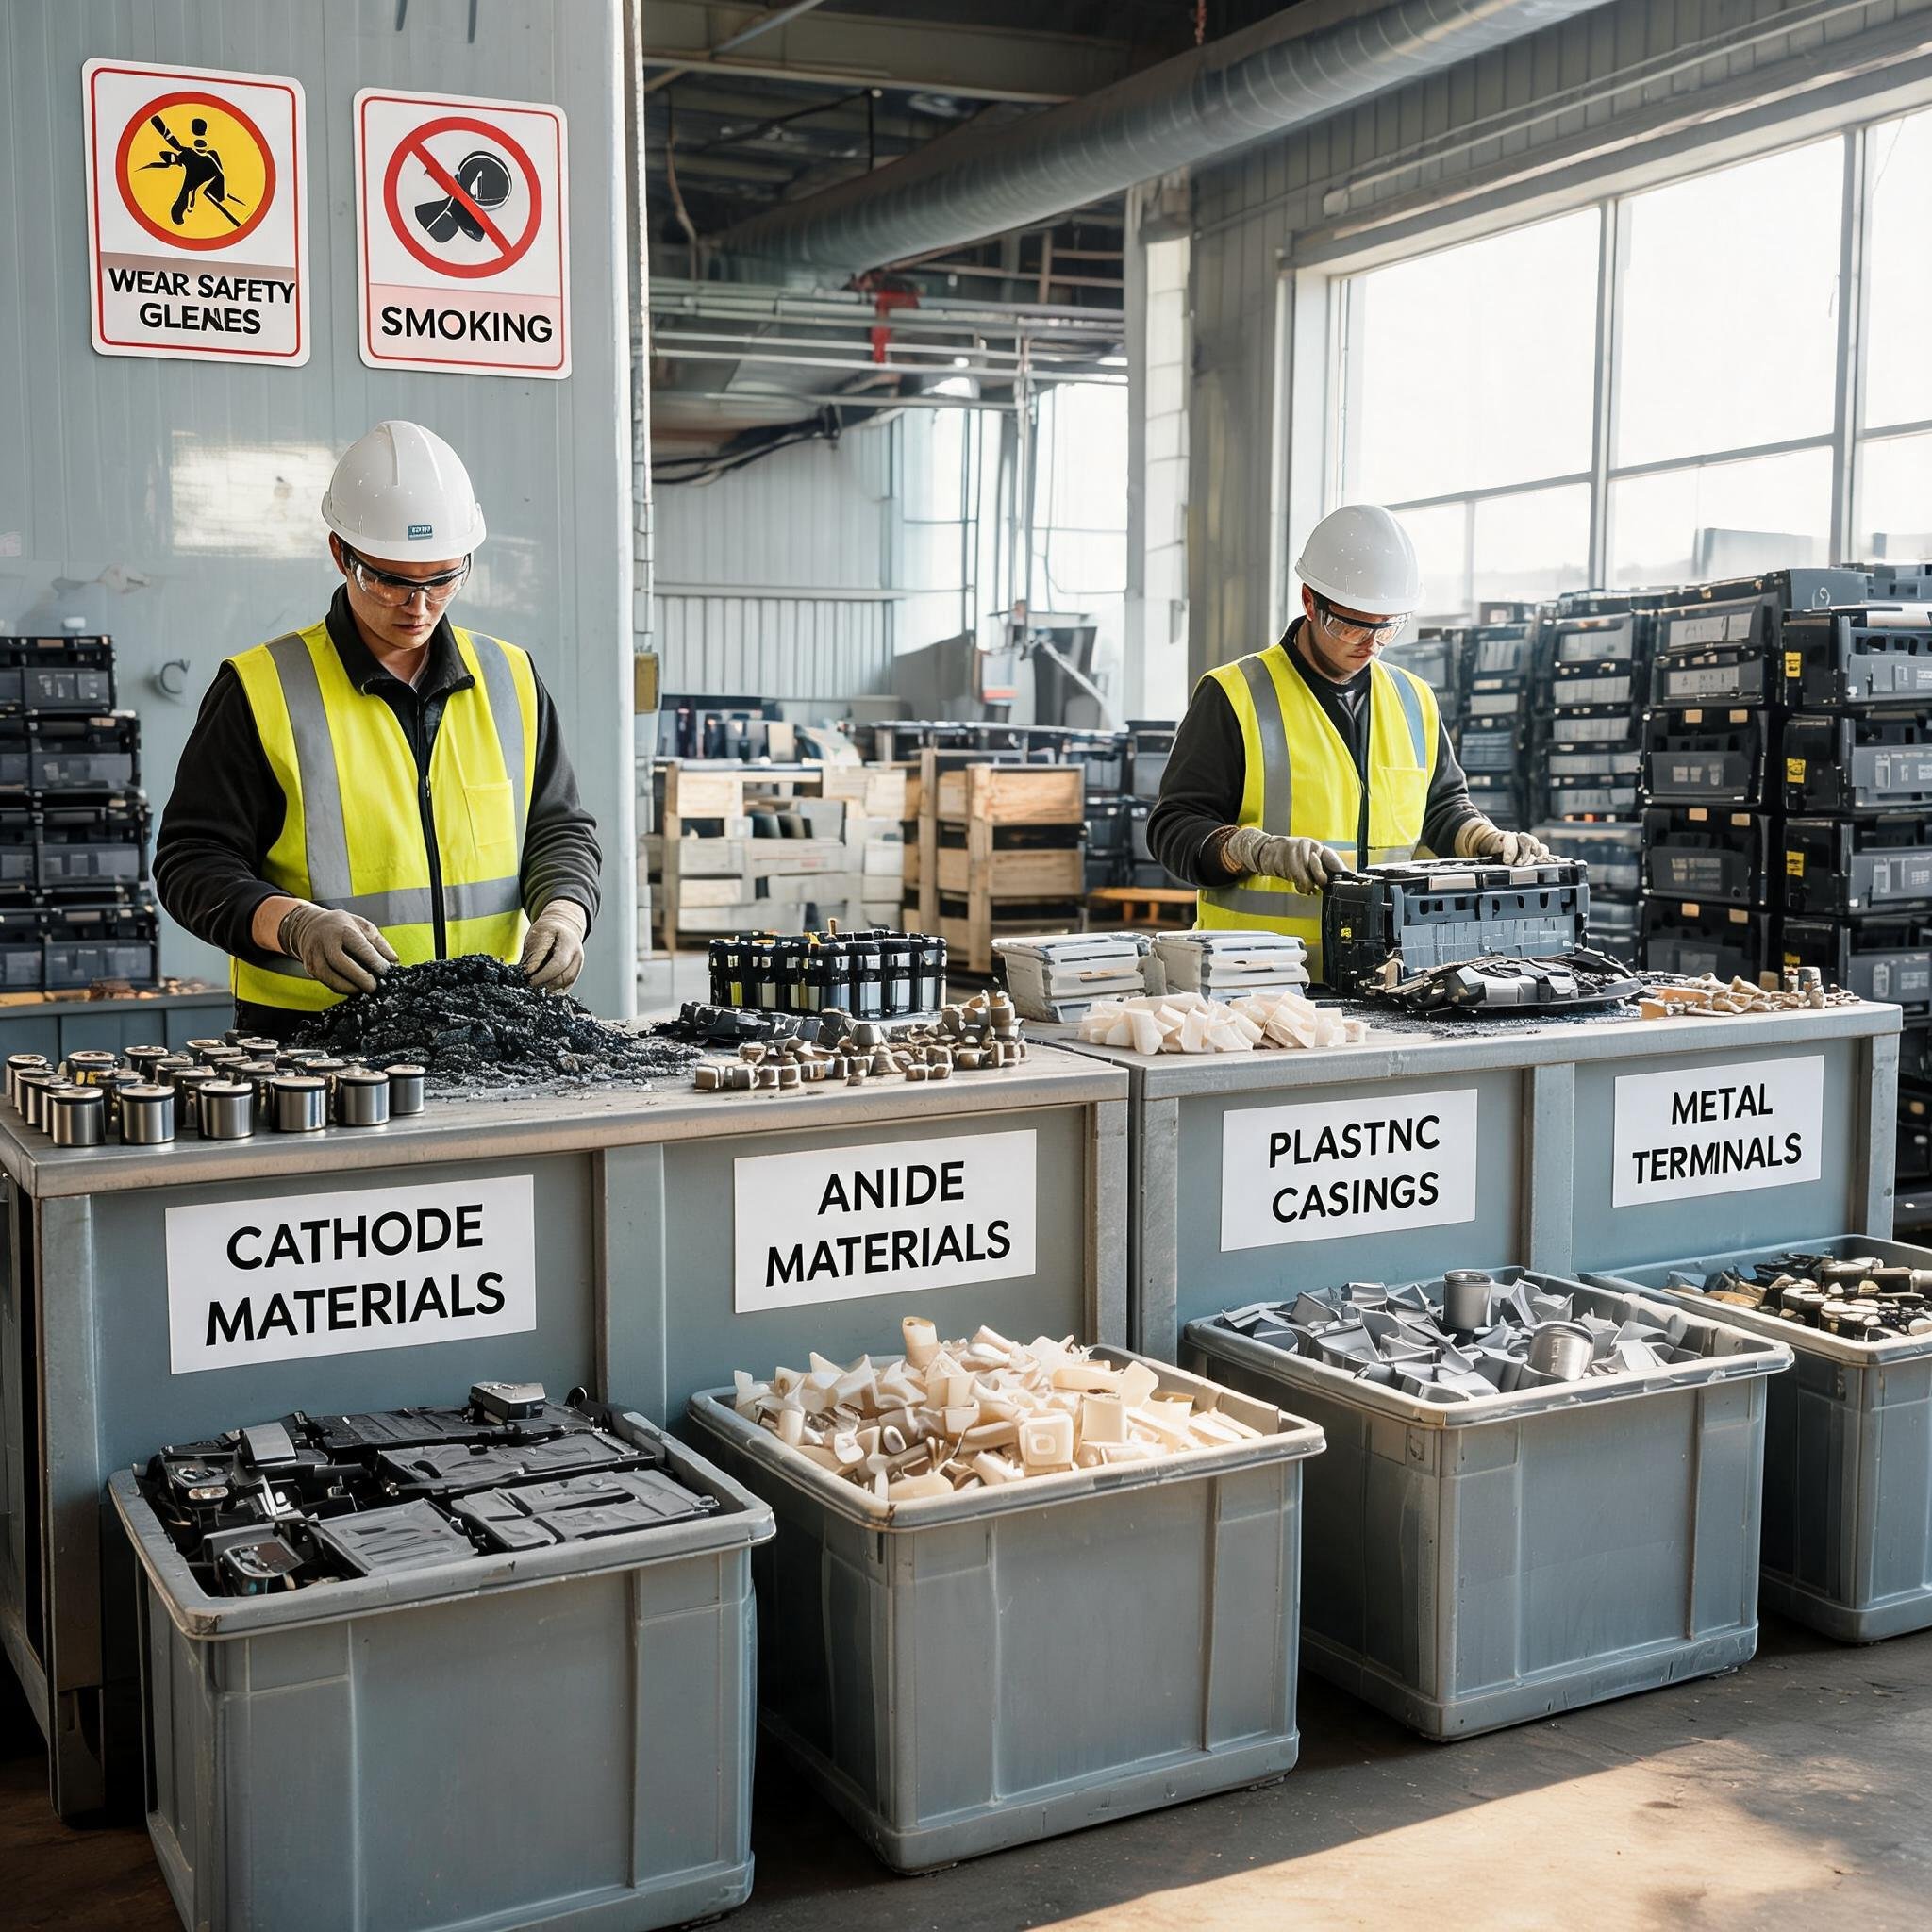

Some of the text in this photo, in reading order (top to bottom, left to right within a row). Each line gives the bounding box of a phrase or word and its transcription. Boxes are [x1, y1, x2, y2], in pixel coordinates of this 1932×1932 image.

[108, 268, 296, 304] WEAR SAFETY
[381, 306, 553, 344] SMOKING
[1671, 1083, 1774, 1125] METAL
[1269, 1114, 1441, 1169] PLASTNC
[1632, 1132, 1803, 1184] TERMINALS
[817, 1160, 965, 1215] ANIDE
[1272, 1171, 1440, 1223] CASINGS
[226, 1203, 484, 1271] CATHODE
[765, 1219, 1011, 1288] MATERIALS
[205, 1271, 506, 1347] MATERIALS
